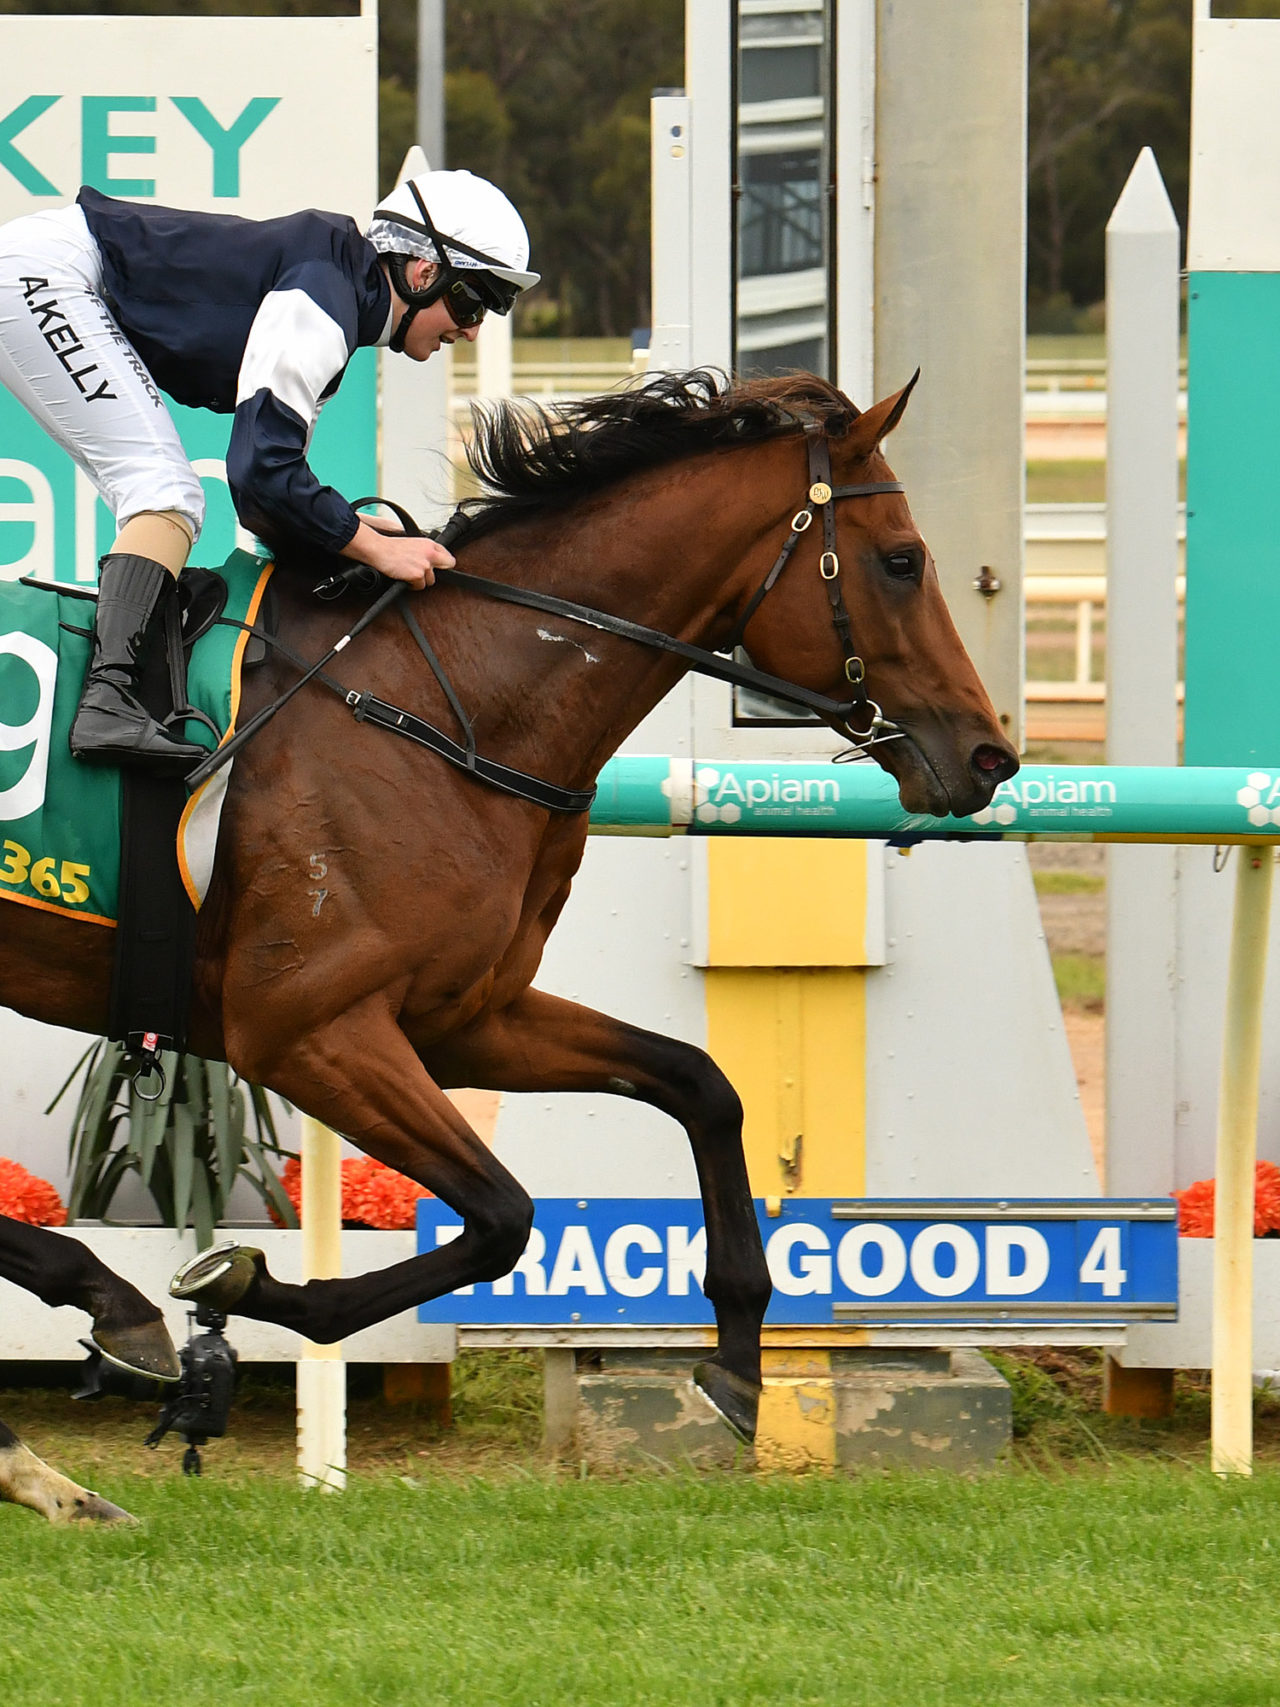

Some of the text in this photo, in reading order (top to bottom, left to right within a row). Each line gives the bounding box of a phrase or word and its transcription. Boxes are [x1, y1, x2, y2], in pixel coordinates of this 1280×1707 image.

[19, 276, 118, 403] A.KELLY
[99, 311, 127, 346] THE
[123, 348, 165, 408] TRACK
[714, 773, 840, 808] Apiam
[991, 775, 1117, 809] Apiam
[753, 805, 836, 816] animal health
[1029, 806, 1112, 816] animal health
[309, 853, 327, 880] 5
[308, 888, 328, 917] 7
[765, 1223, 1050, 1298] GOOD
[1079, 1227, 1126, 1297] 4
